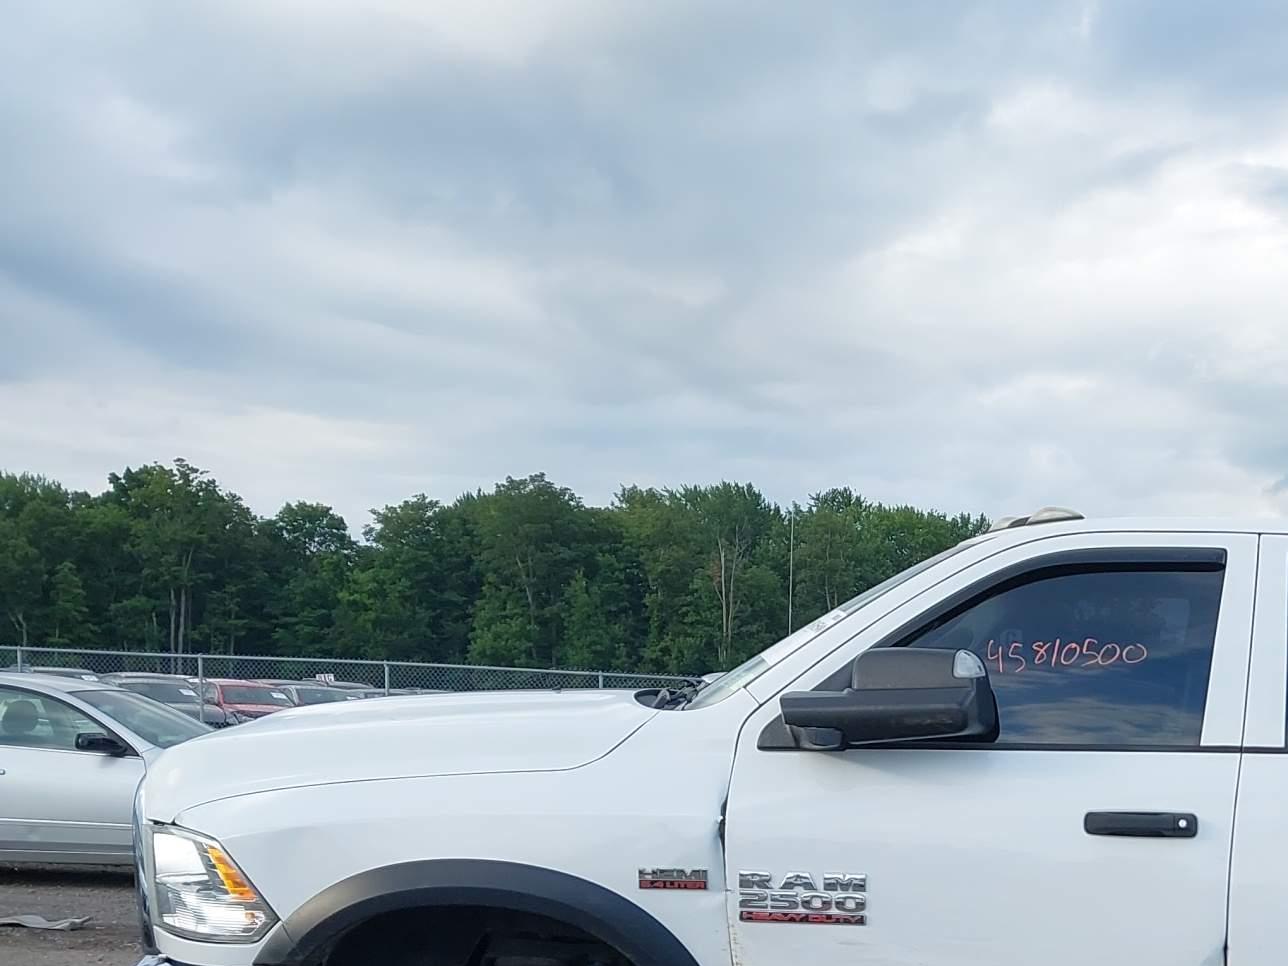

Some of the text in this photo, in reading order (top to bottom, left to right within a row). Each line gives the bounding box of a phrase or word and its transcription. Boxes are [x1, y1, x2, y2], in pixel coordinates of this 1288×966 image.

[987, 638, 1147, 673] 45810500
[639, 869, 708, 880] HEMI
[739, 870, 866, 892] RAM
[665, 881, 705, 889] LITER
[739, 890, 866, 913] 2500
[742, 911, 864, 924] HEAVY DUTY
